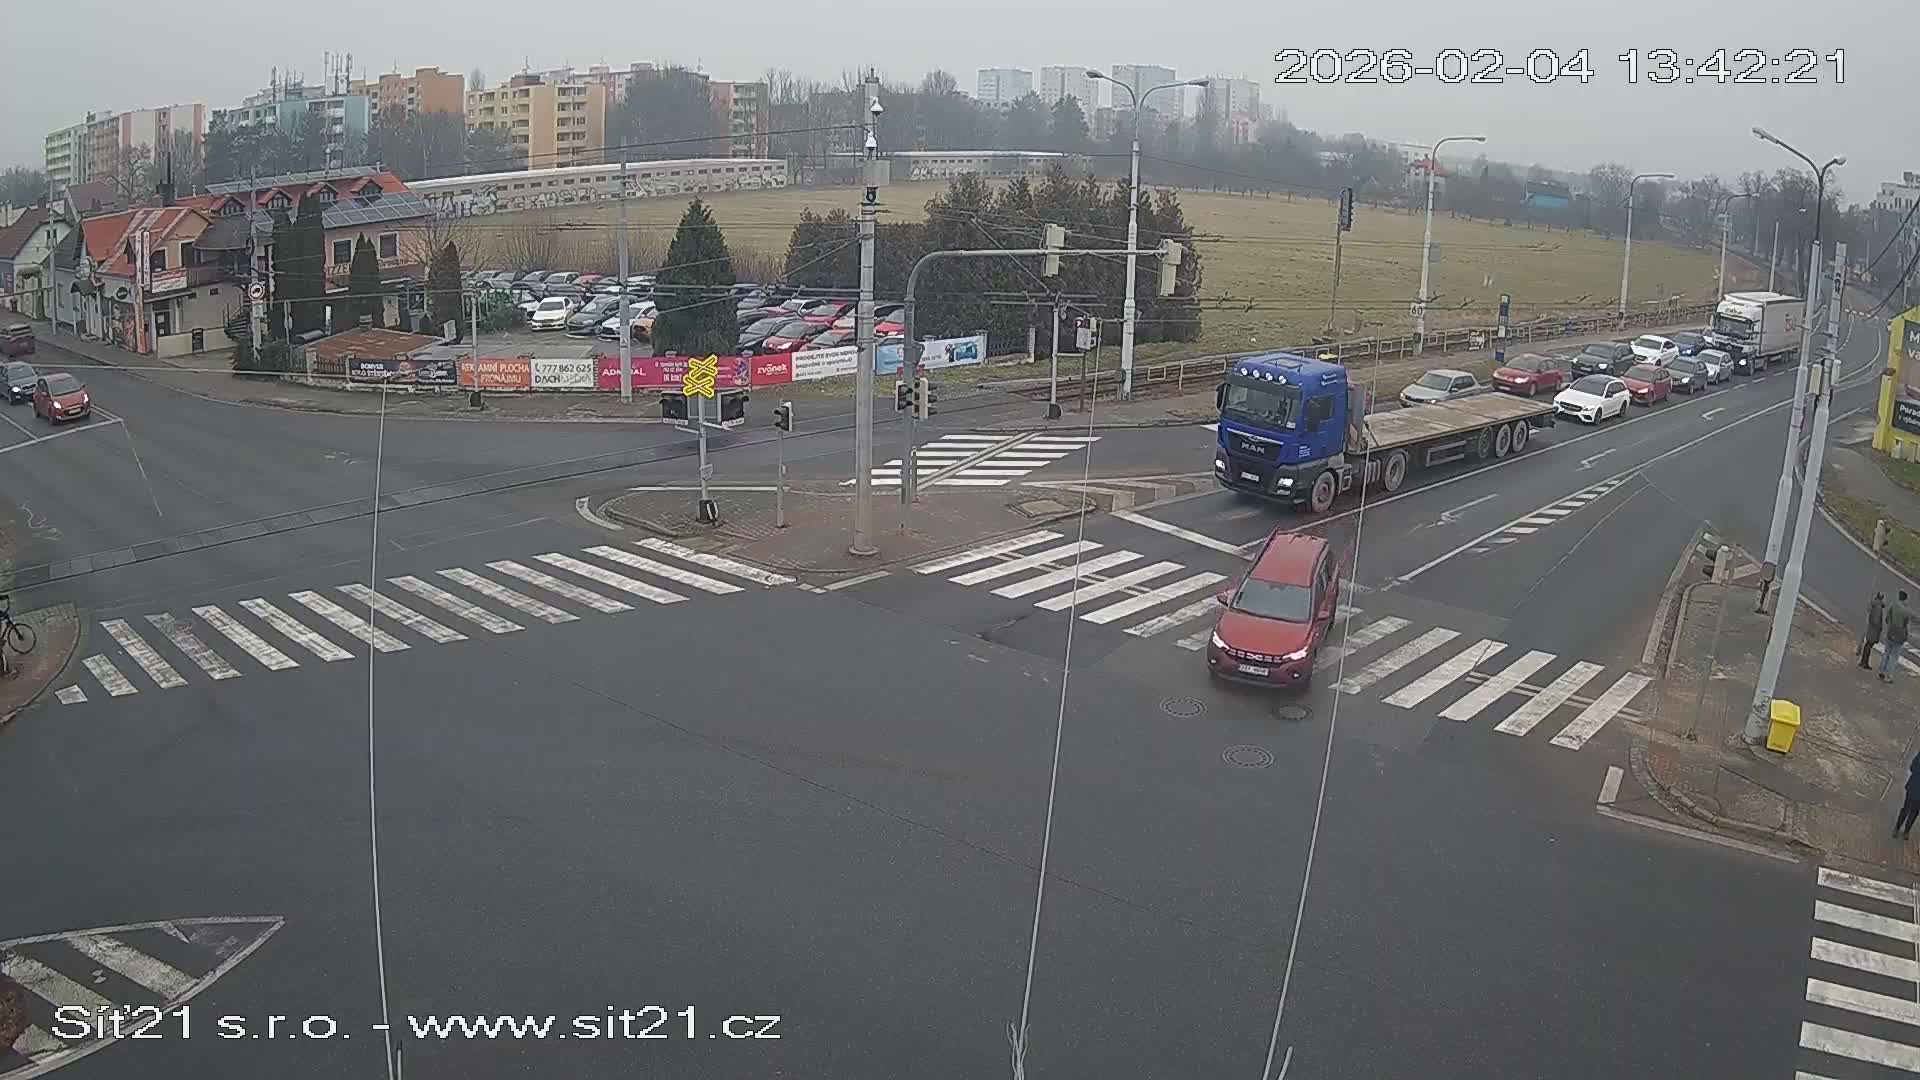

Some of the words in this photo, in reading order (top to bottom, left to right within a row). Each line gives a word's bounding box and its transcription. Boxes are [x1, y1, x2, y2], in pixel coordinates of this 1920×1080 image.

[1411, 305, 1423, 316] 60
[461, 361, 498, 373] REKAMNÍ
[499, 363, 530, 373] PLOCHA
[541, 364, 558, 373] 777
[558, 364, 575, 373] 862
[575, 364, 592, 373] 625
[602, 367, 647, 377] ADMAL
[1241, 441, 1265, 454] MAN
